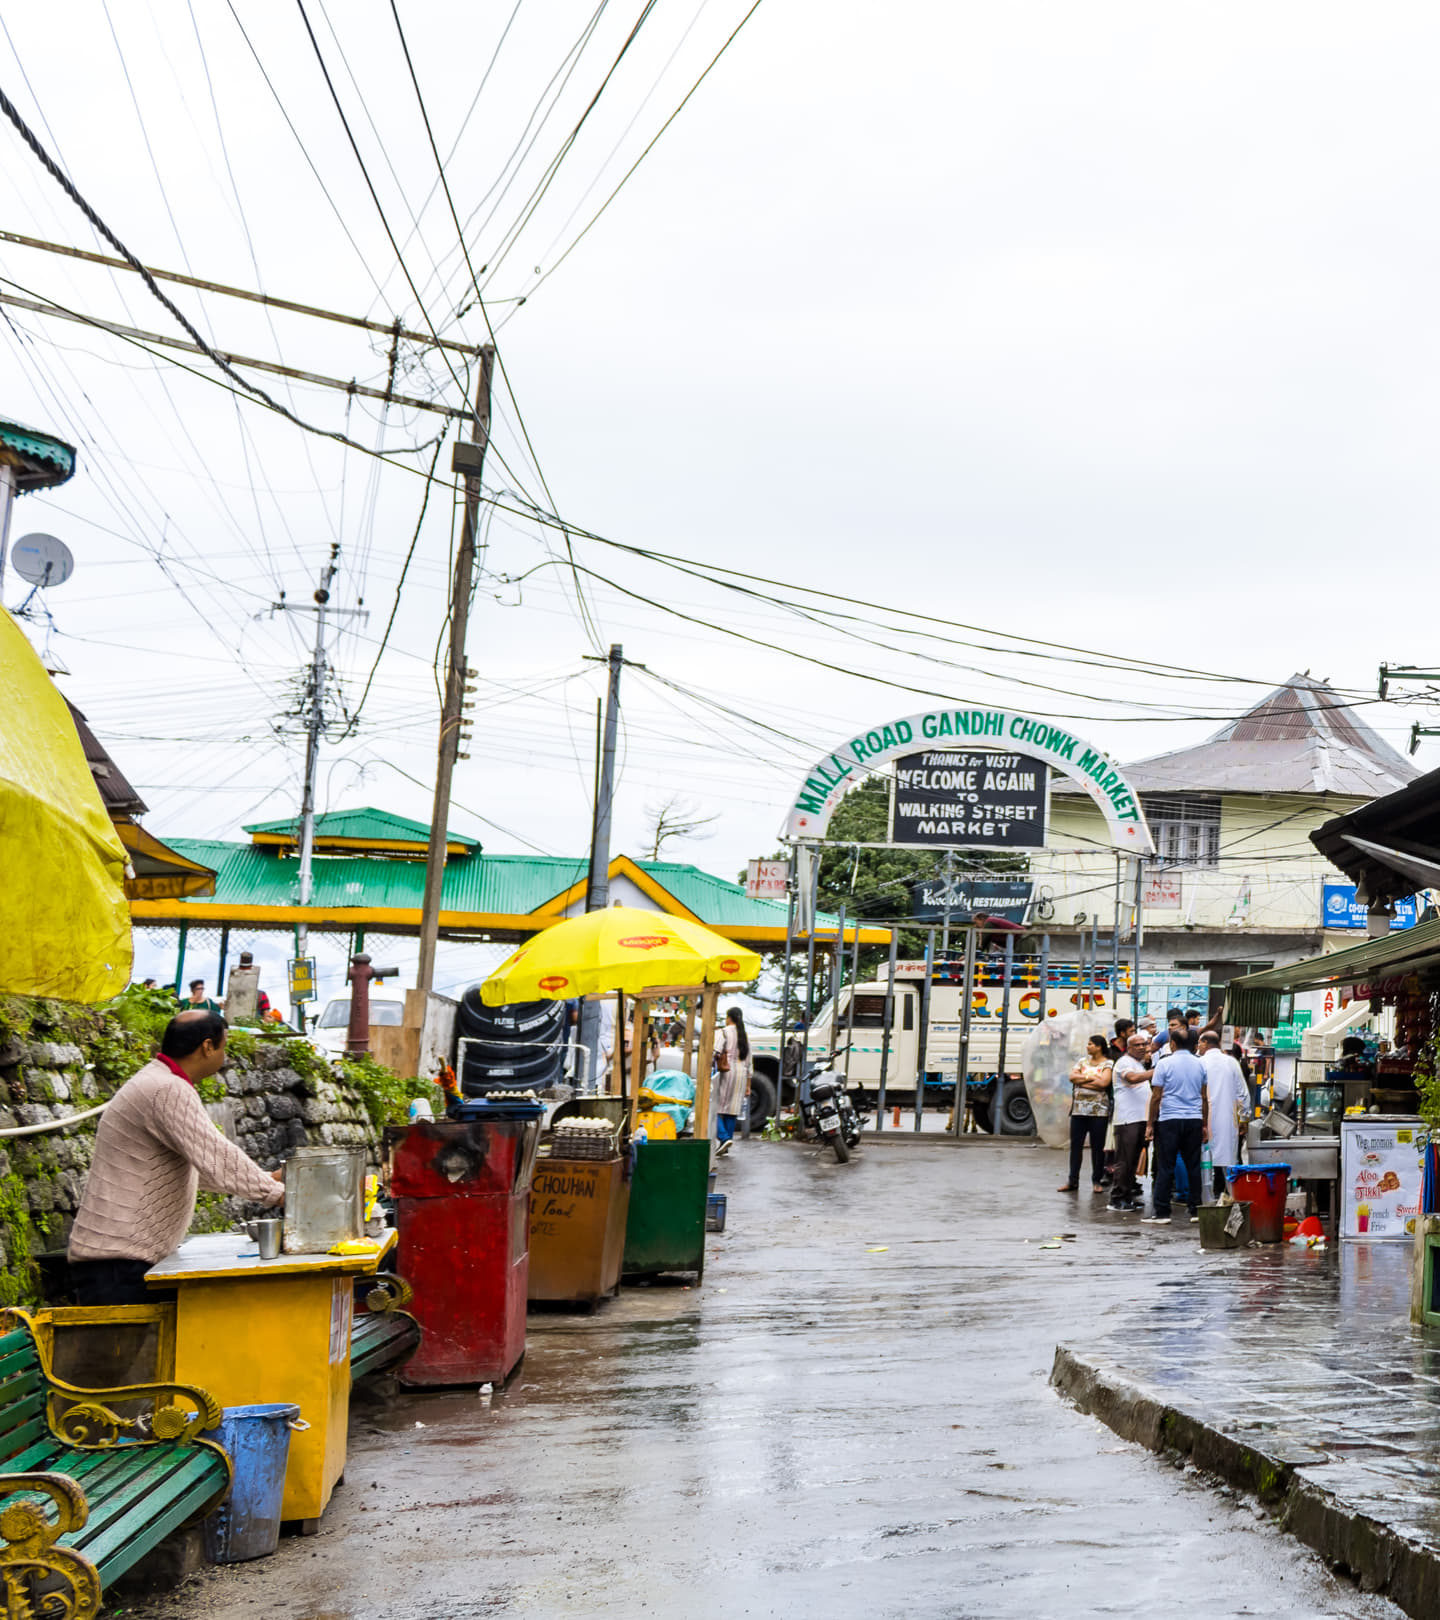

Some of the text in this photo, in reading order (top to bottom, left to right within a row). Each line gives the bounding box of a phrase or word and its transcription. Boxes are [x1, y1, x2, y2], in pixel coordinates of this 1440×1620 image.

[795, 711, 1139, 822] MALL ROAD GANDHI CHOWK MARKET
[921, 753, 968, 767] THANKS
[985, 755, 1021, 768] VISIT
[896, 769, 1036, 791] WELCOME AGAIN
[957, 792, 979, 803] TO
[898, 803, 1038, 820] WALKING STREET
[916, 820, 1011, 837] MARKET
[972, 897, 1028, 908] RESTAURANT
[1356, 1169, 1378, 1184] Aloo
